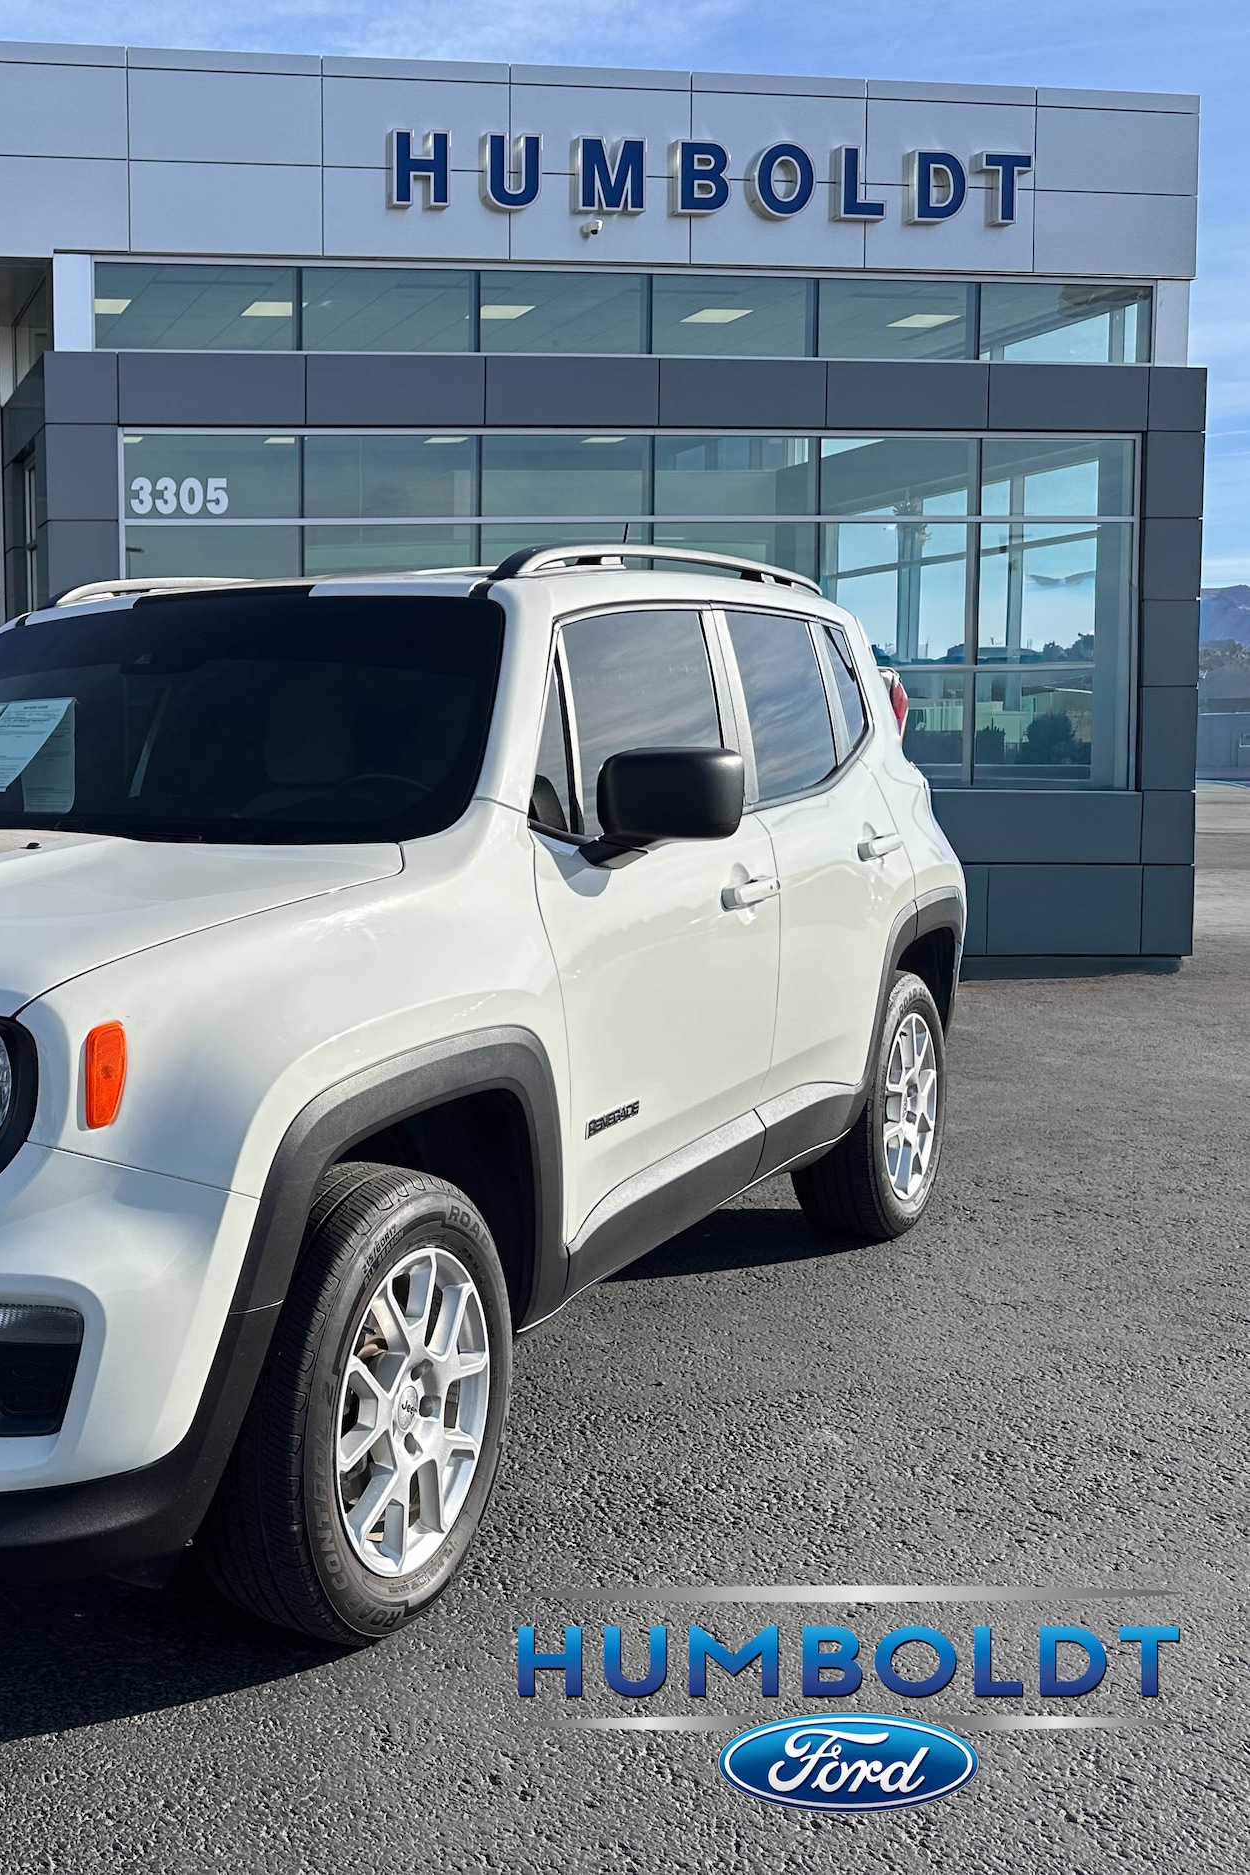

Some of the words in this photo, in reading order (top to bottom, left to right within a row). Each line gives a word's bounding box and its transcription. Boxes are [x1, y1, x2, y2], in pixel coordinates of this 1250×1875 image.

[386, 128, 1034, 226] HUMBOLDT
[130, 476, 229, 515] 3305
[585, 1099, 640, 1140] RENEGADE
